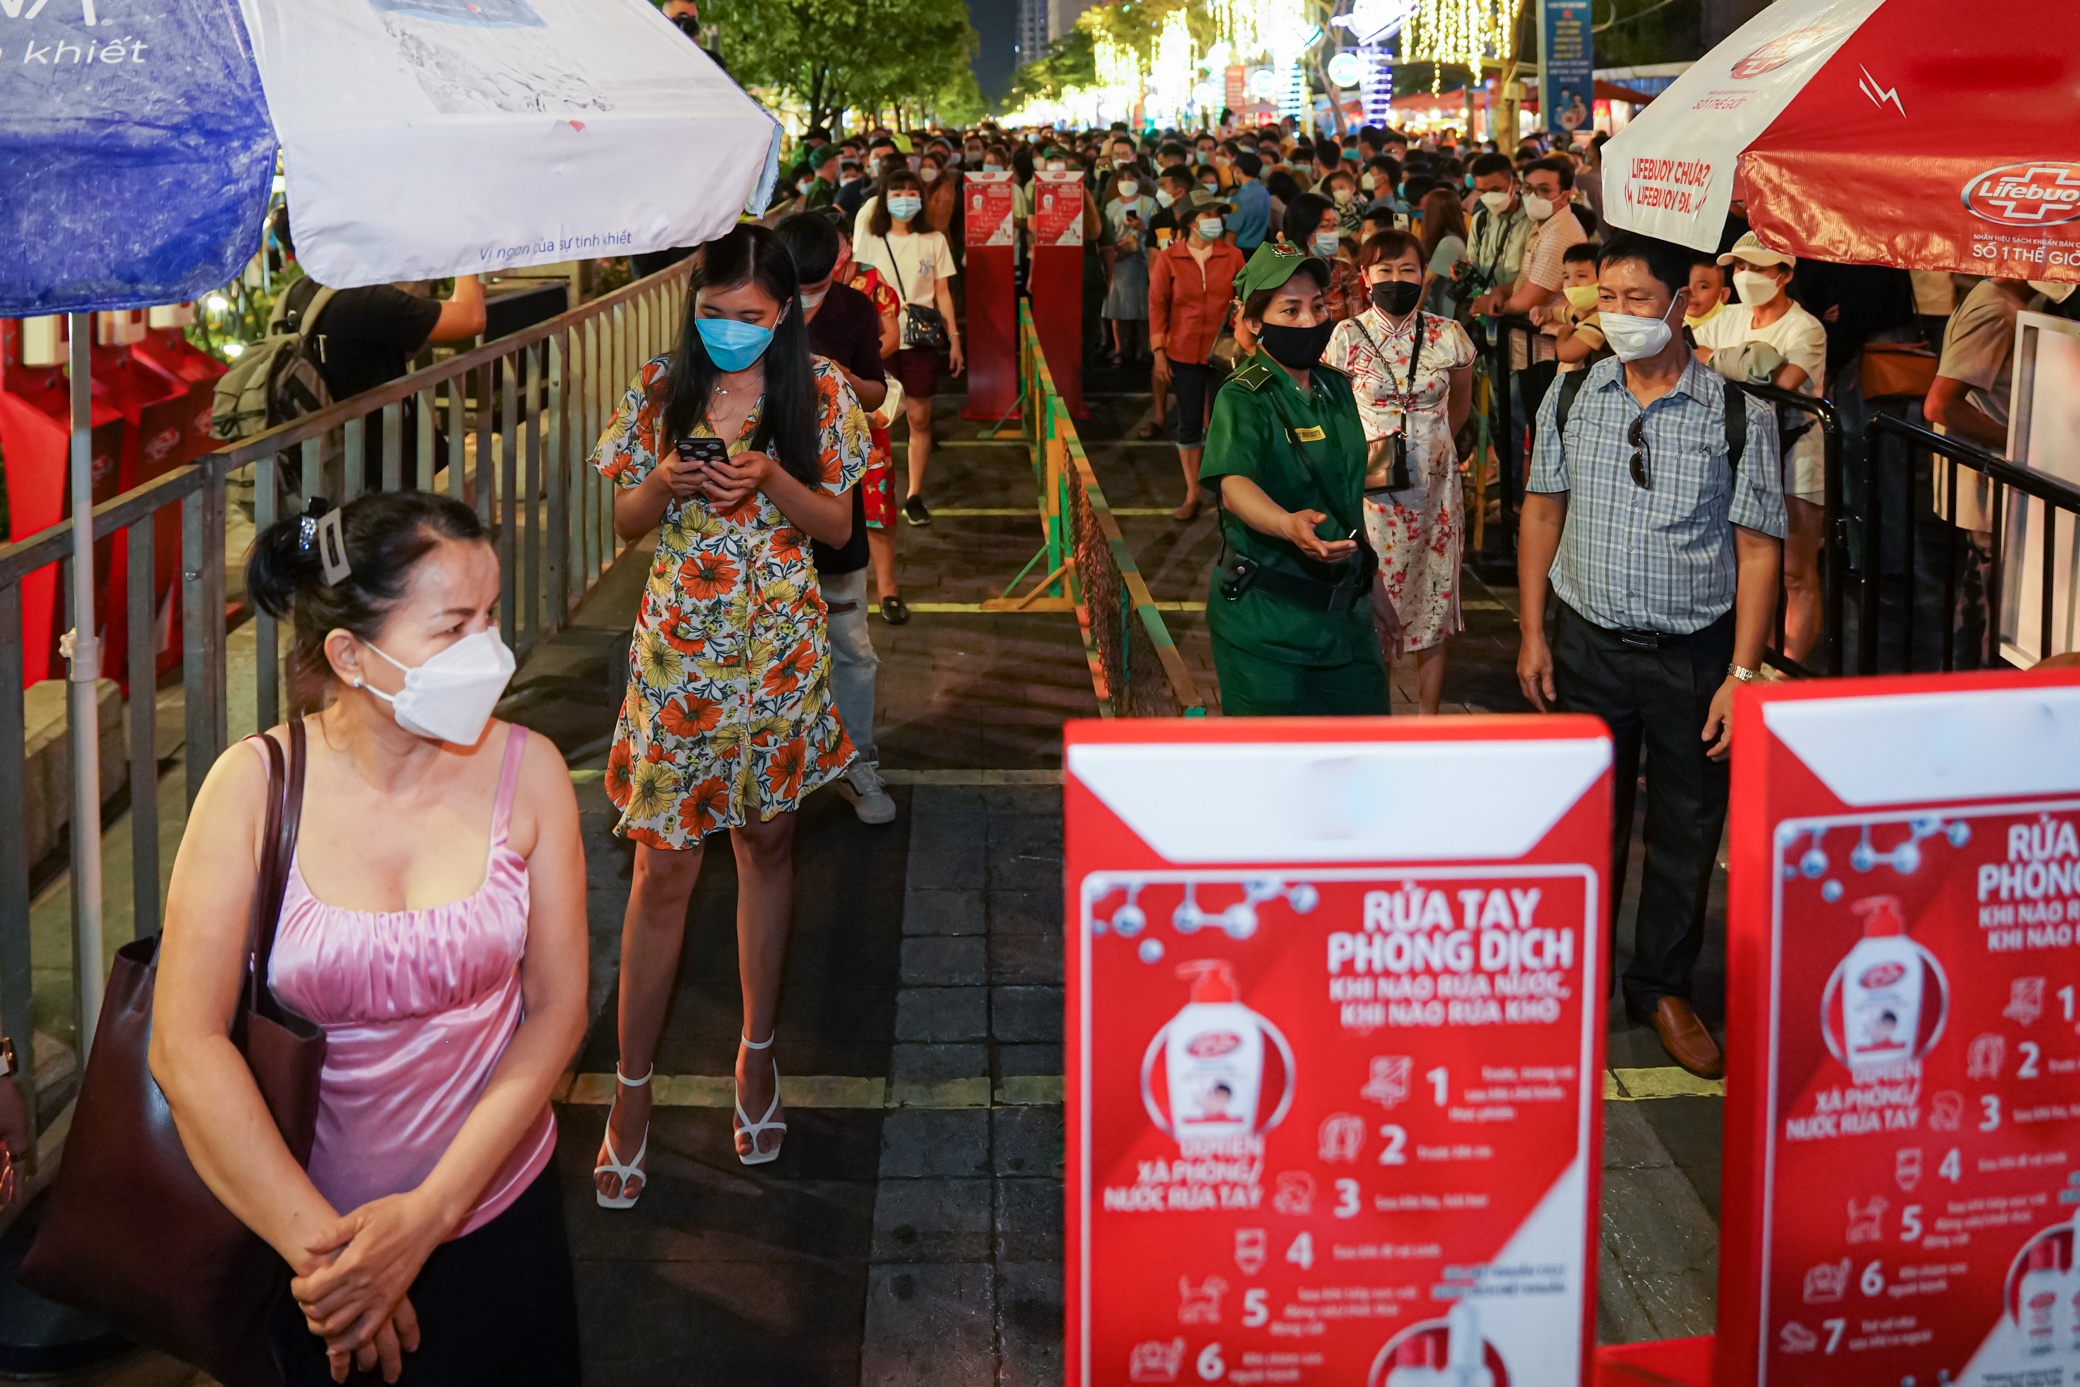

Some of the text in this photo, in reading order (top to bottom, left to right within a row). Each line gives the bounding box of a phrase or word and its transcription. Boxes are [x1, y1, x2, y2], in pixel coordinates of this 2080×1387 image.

[24, 35, 148, 64] khiết
[1631, 157, 1675, 182] LIFEBUOY
[1636, 185, 1679, 211] LIFEBUOY
[1978, 181, 2080, 204] Lifebuo
[559, 237, 574, 253] sự
[602, 228, 632, 246] khiết
[1972, 241, 1997, 258] SỐ
[2002, 246, 2009, 260] 1
[2012, 246, 2046, 263] THẾ
[2008, 812, 2079, 861] RỬA
[1363, 880, 1542, 932] RỬA TAY
[1479, 927, 1574, 977] DỊCH
[2057, 984, 2075, 1022] 1
[2016, 1041, 2040, 1079] 2
[1426, 1066, 1448, 1107] 1
[1978, 1094, 2001, 1132] 3
[1379, 1124, 1407, 1165] 2
[1938, 1147, 1962, 1182] 4
[1333, 1178, 1361, 1218] 3
[1900, 1204, 1923, 1242] 5
[1285, 1231, 1314, 1270] 4
[1859, 1260, 1885, 1297] 6
[1242, 1288, 1269, 1327] 5
[1822, 1318, 1846, 1355] 7
[1196, 1342, 1225, 1381] 6
